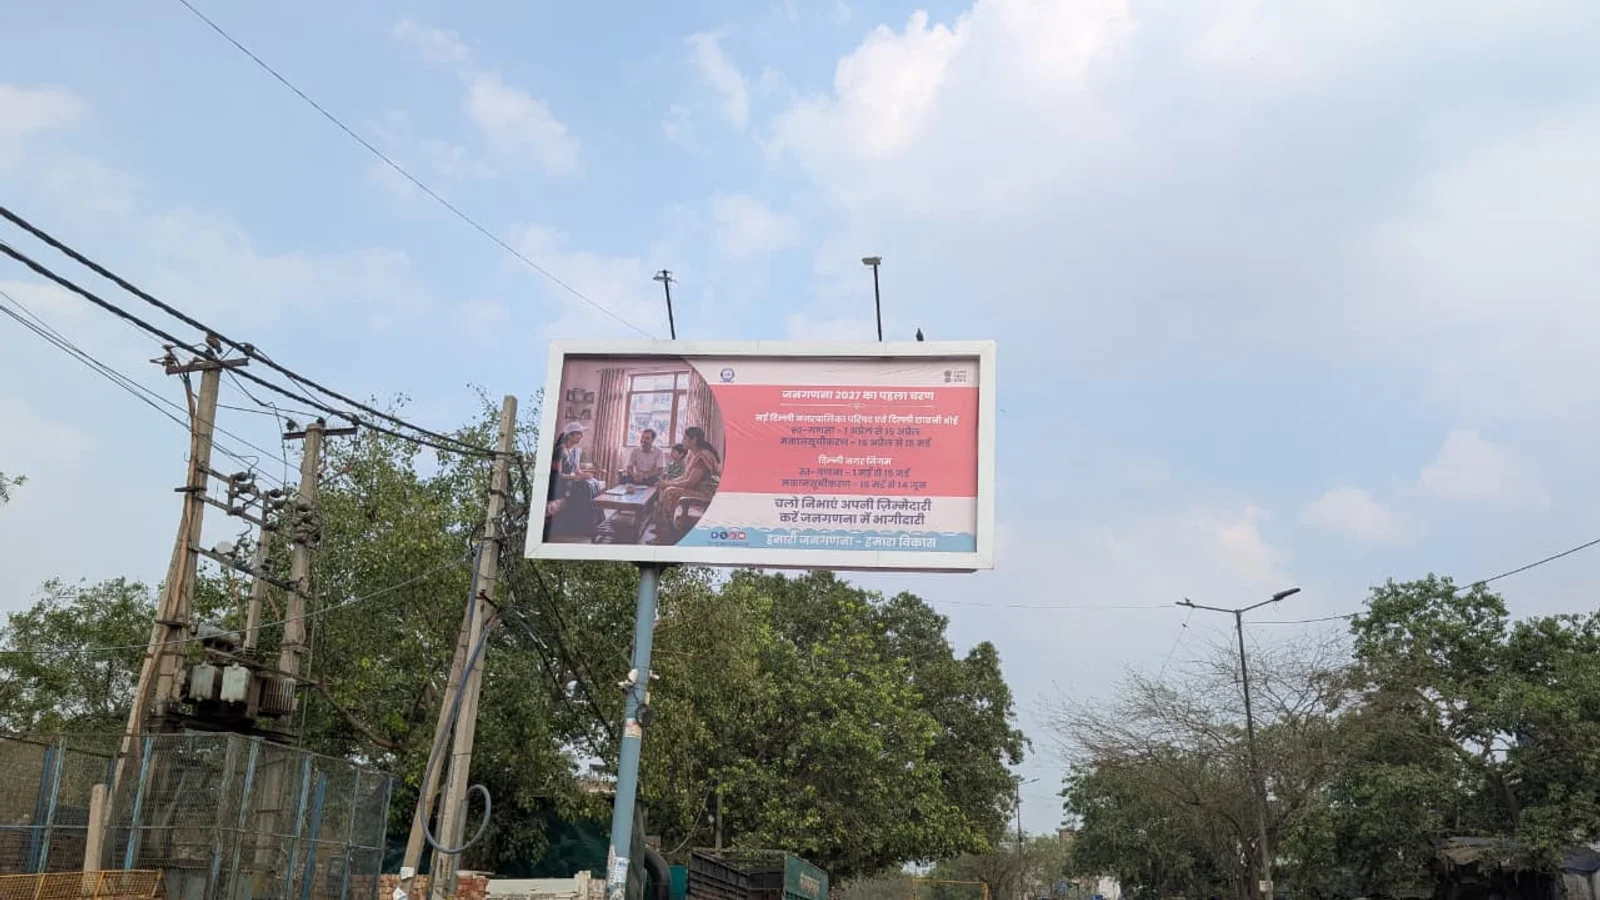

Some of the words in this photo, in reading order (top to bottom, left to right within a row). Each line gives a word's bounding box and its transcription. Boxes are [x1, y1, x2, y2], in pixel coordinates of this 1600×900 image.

[835, 391, 861, 399] 2027
[862, 391, 877, 400] का
[879, 391, 908, 401] पहला
[909, 391, 935, 400] चरण
[774, 496, 800, 508] चलो
[800, 496, 838, 509] निभाएं
[841, 497, 875, 510] अपनी
[779, 510, 799, 522] करें
[800, 512, 857, 524] जनगणना
[860, 511, 872, 524] में
[872, 511, 926, 525] भागीदारी
[799, 534, 854, 546] जनगणना
[898, 533, 937, 548] विकास
